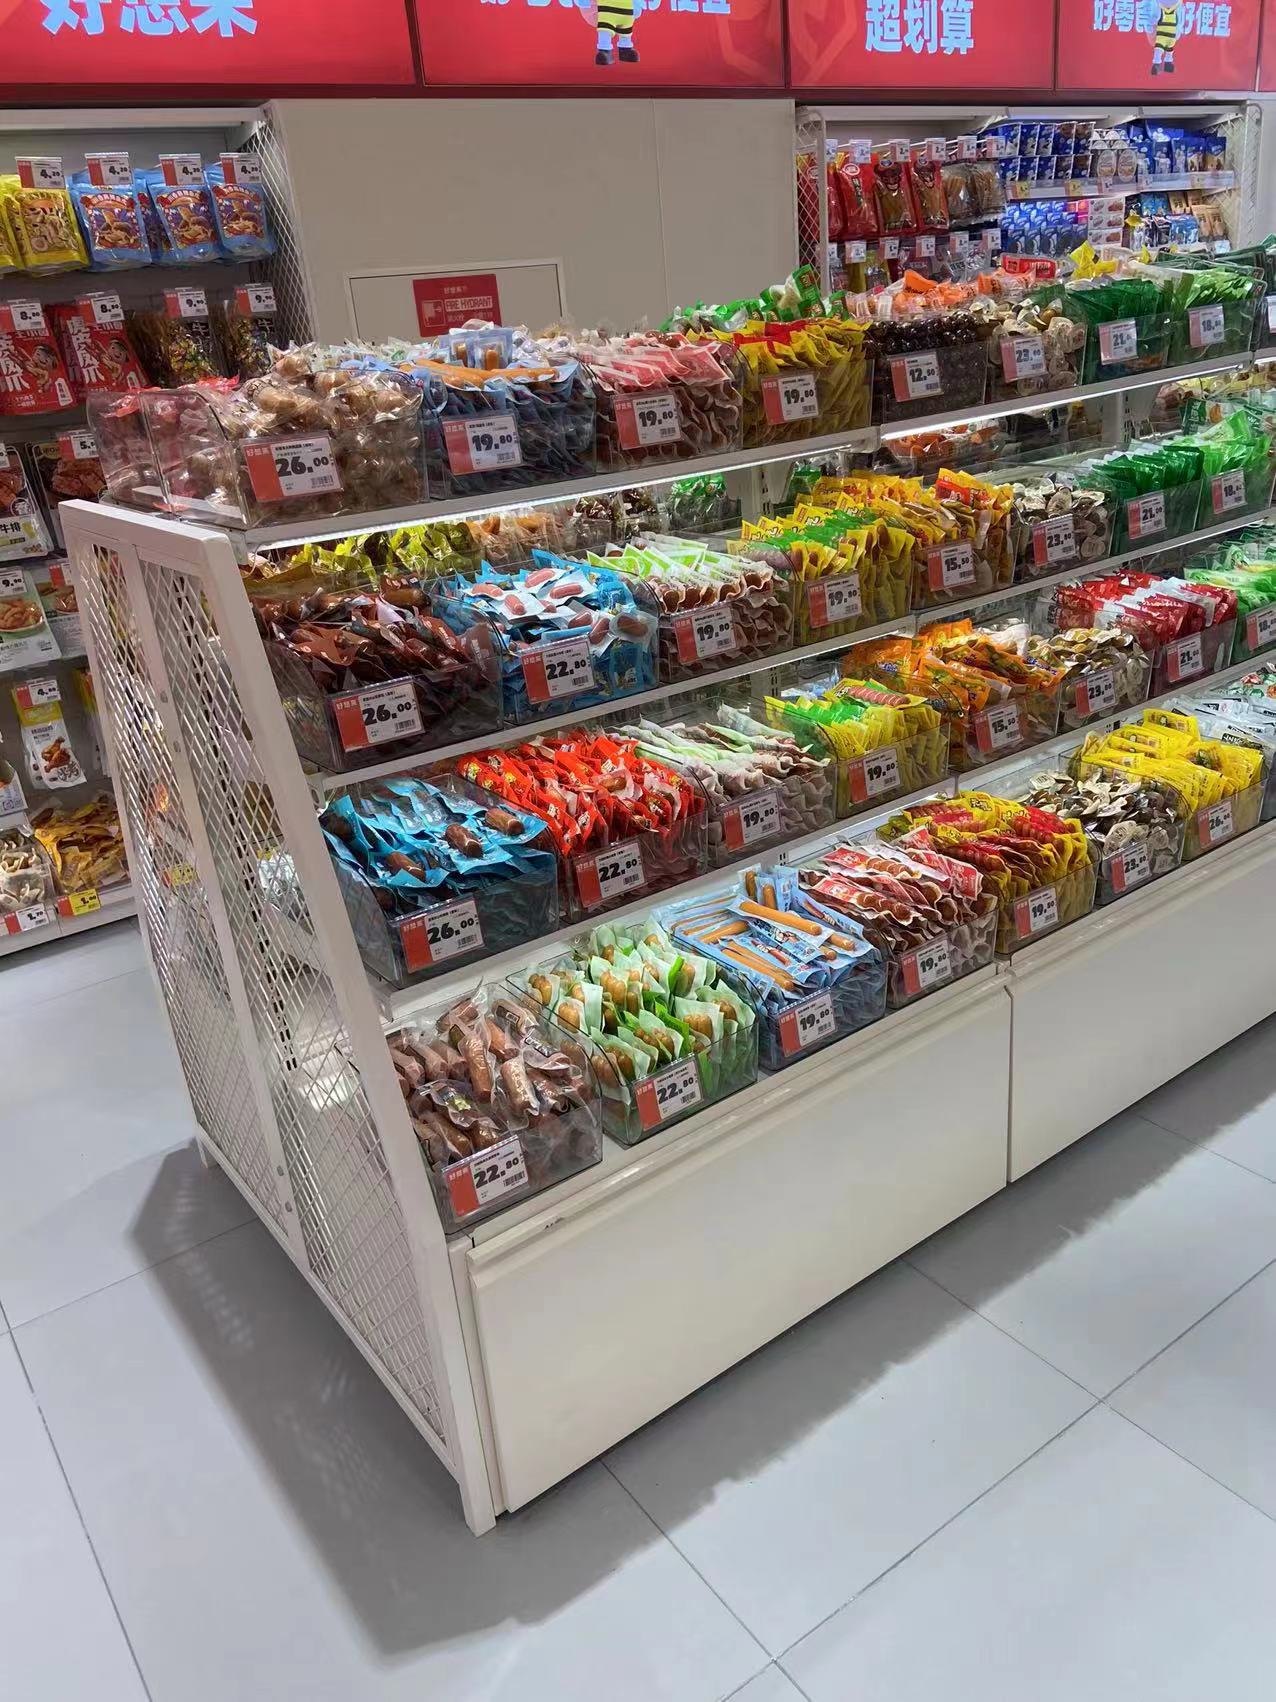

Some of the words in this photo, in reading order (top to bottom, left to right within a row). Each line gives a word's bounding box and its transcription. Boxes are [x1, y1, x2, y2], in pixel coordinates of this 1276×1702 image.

[865, 0, 974, 55] 超划算
[784, 389, 814, 404] 19.80
[638, 410, 674, 427] 19.80
[472, 434, 513, 452] 19.80
[275, 456, 329, 477] 26.00
[828, 590, 858, 606] 19.80
[697, 623, 730, 641] 19.80
[546, 660, 586, 680] 22.80
[362, 702, 412, 726] 26.00
[867, 763, 895, 781] 19.80
[744, 808, 775, 828] 19.80
[599, 858, 637, 883] 22.80
[427, 918, 475, 945] 26.00
[920, 953, 947, 973] 19.80
[799, 1009, 830, 1031] 19.80
[657, 1077, 694, 1105] 22.80
[473, 1157, 519, 1189] 22.80
